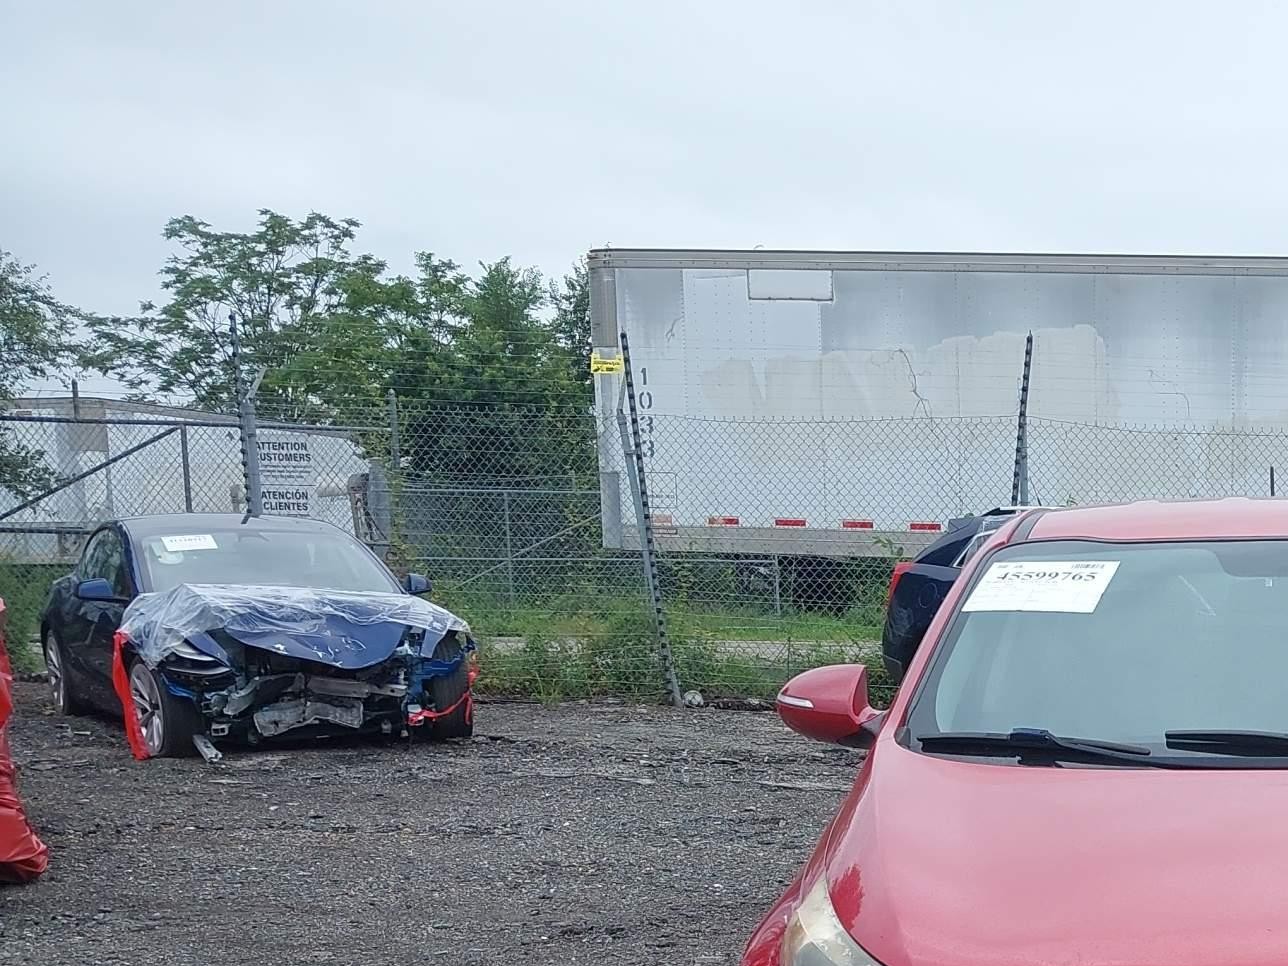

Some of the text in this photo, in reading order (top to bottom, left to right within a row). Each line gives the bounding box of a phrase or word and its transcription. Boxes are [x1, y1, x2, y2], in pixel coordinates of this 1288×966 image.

[639, 368, 654, 457] 1033
[258, 453, 311, 462] USTOMERS
[261, 489, 308, 500] ATENCIÓN
[263, 502, 309, 511] CLIENTES
[996, 571, 1098, 582] 45599765
